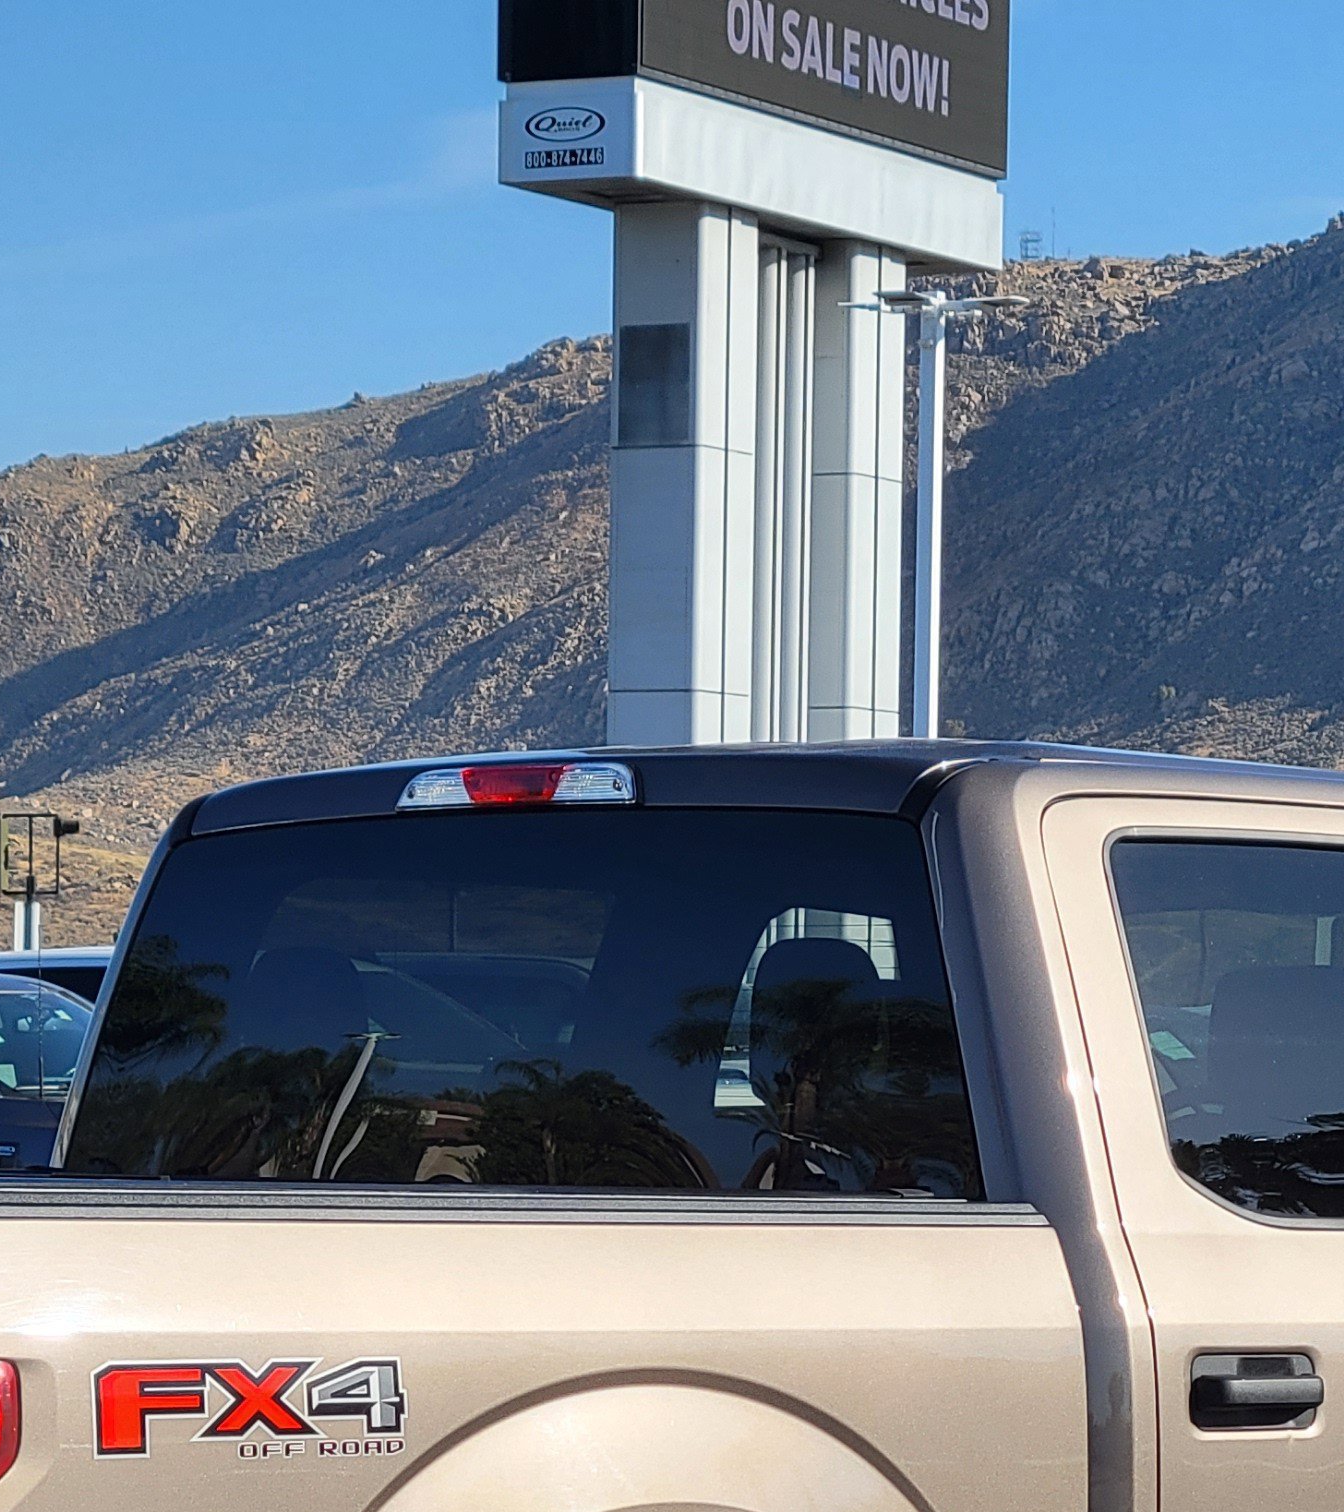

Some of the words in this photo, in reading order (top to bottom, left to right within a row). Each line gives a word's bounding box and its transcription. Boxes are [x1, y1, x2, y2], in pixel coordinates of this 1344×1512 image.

[727, 0, 774, 63] ON
[781, 9, 860, 90] SALE
[867, 35, 950, 117] NOW!
[90, 1357, 409, 1459] FX4
[238, 1441, 305, 1459] OFF
[318, 1438, 406, 1458] ROAD
